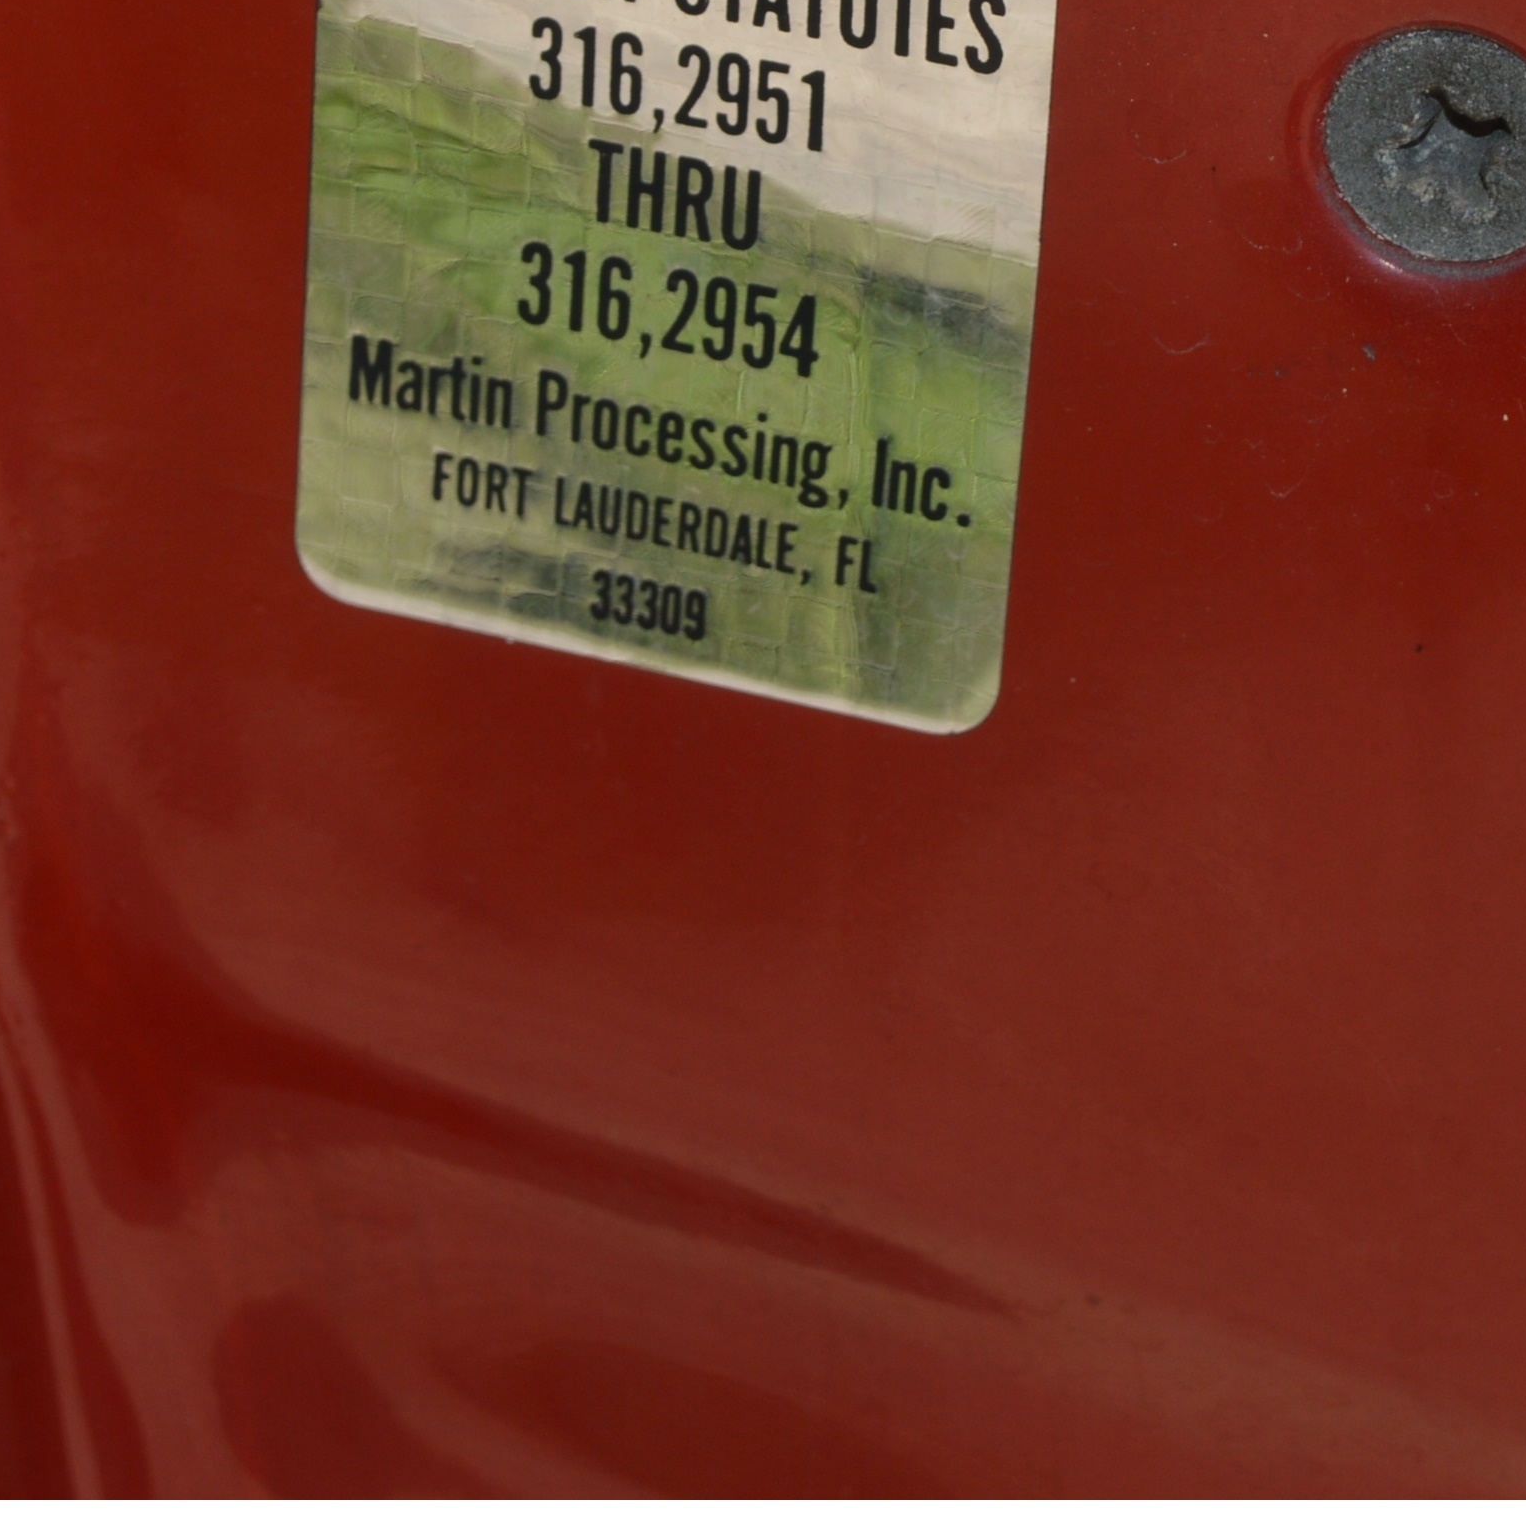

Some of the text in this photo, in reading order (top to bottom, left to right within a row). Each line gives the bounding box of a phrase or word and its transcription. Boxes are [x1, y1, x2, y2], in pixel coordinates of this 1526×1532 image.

[528, 16, 826, 152] 316,2951
[587, 137, 763, 251] THRU
[516, 240, 820, 378] 316,2954
[348, 334, 973, 528] Martin Processing, Inc.
[431, 452, 879, 595] FORT LAUDERDALE, FL
[589, 569, 709, 642] 33309
